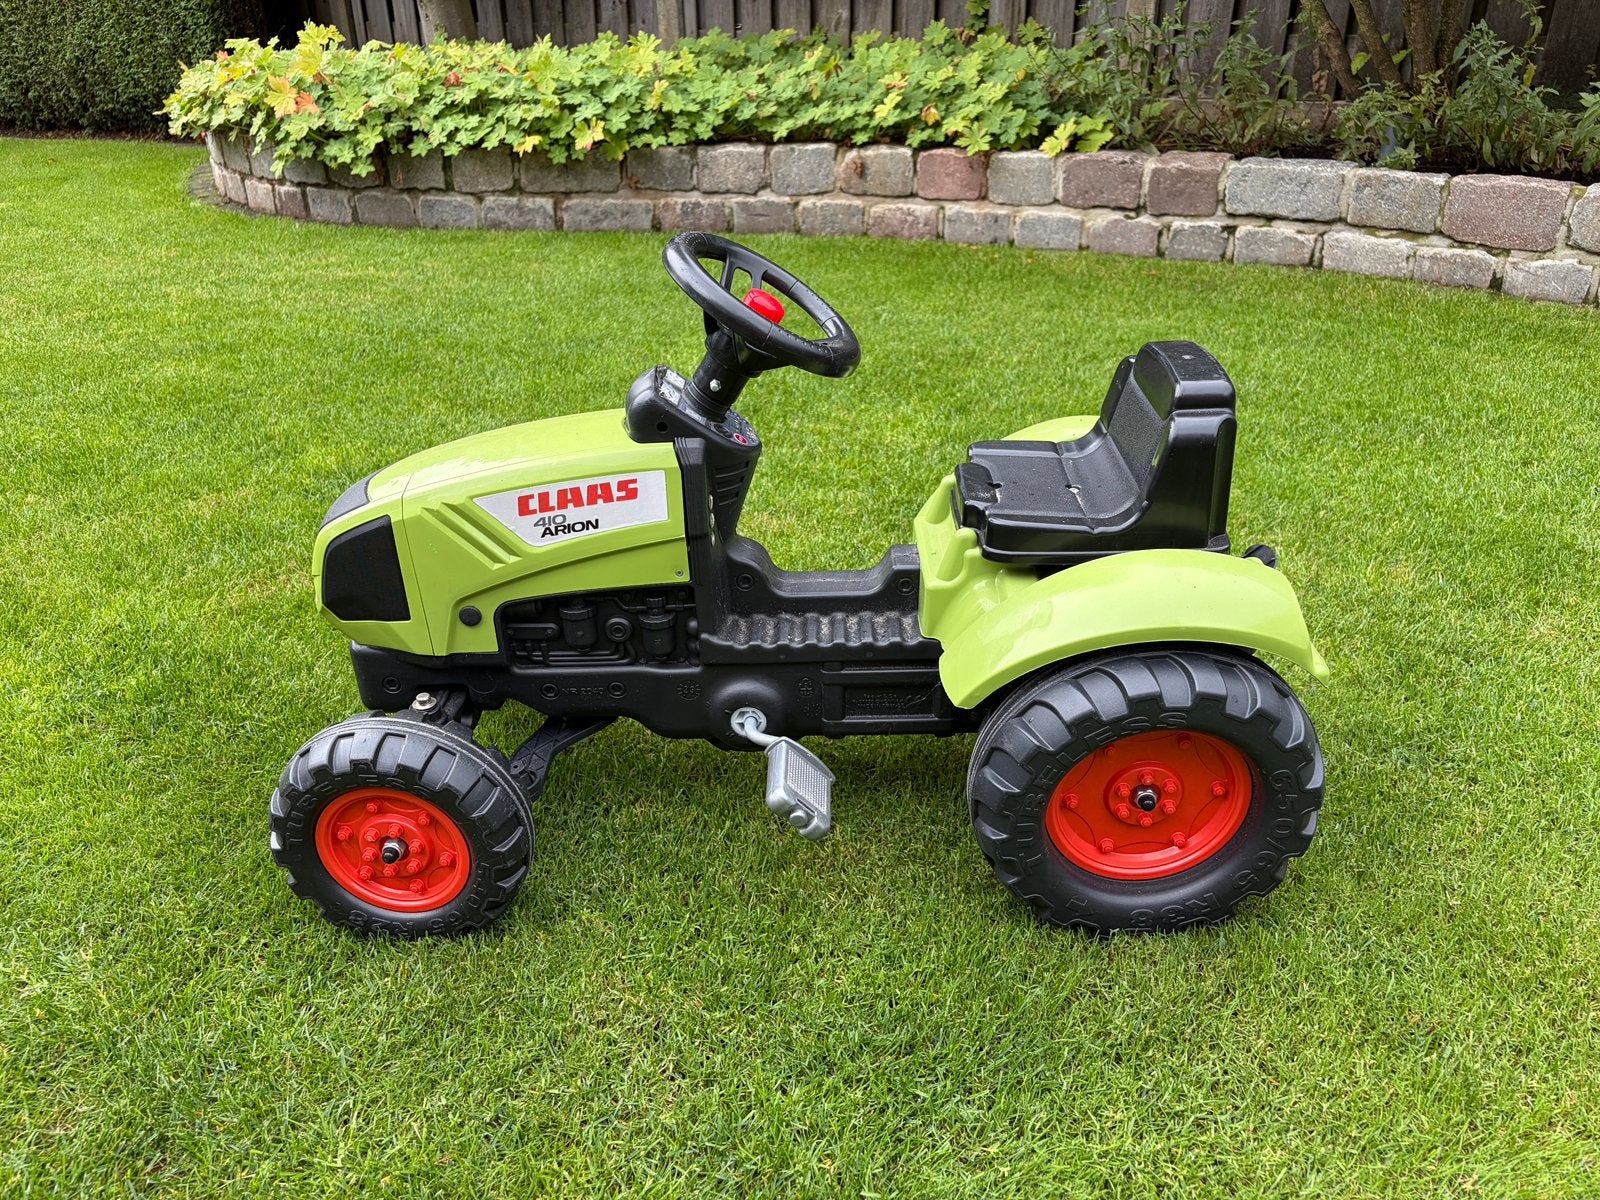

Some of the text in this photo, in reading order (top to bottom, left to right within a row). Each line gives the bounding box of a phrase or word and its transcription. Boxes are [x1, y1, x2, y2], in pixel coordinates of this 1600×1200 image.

[517, 478, 639, 517] CLAAS
[533, 513, 567, 528] 410
[540, 518, 600, 538] ARION
[286, 774, 434, 850] TUBELESS
[1016, 711, 1189, 876] TUBELESS
[1232, 769, 1298, 892] 650/65
